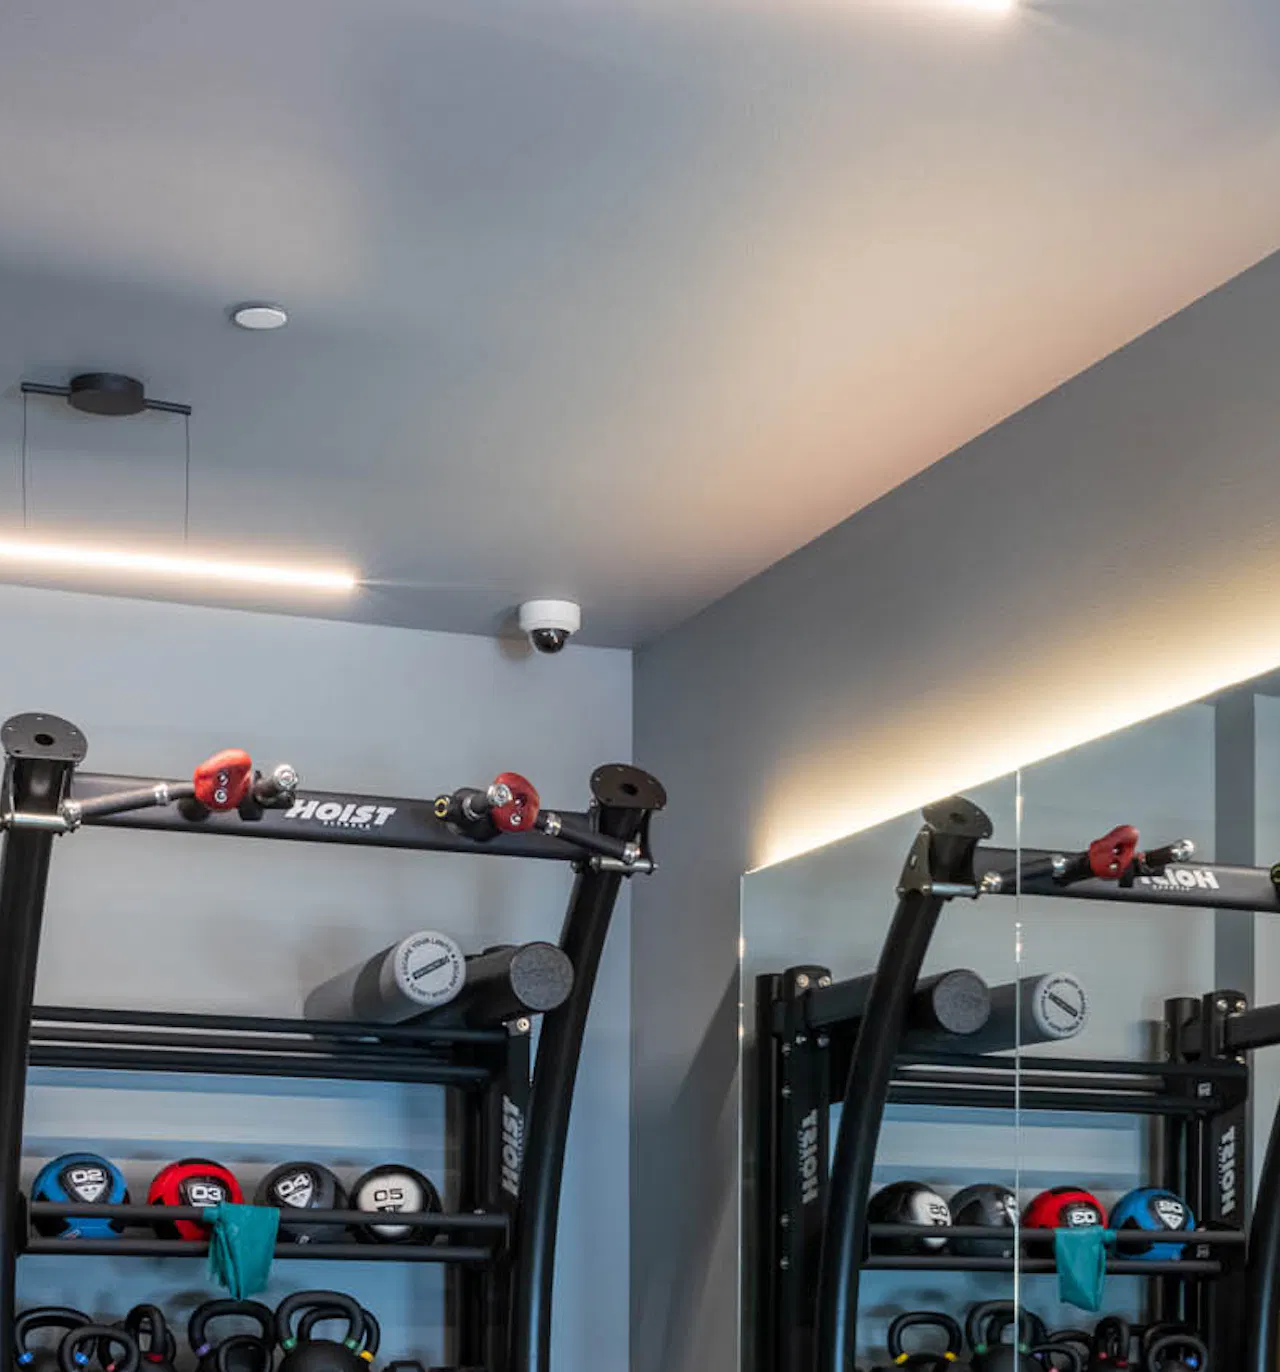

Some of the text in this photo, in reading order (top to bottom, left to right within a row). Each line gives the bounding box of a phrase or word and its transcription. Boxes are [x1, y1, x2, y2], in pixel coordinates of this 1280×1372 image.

[284, 799, 397, 826] HOIST
[502, 1094, 520, 1196] HOIST
[71, 1168, 104, 1184] 02
[277, 1173, 311, 1196] 04
[191, 1185, 221, 1201] 03
[373, 1188, 404, 1202] 05
